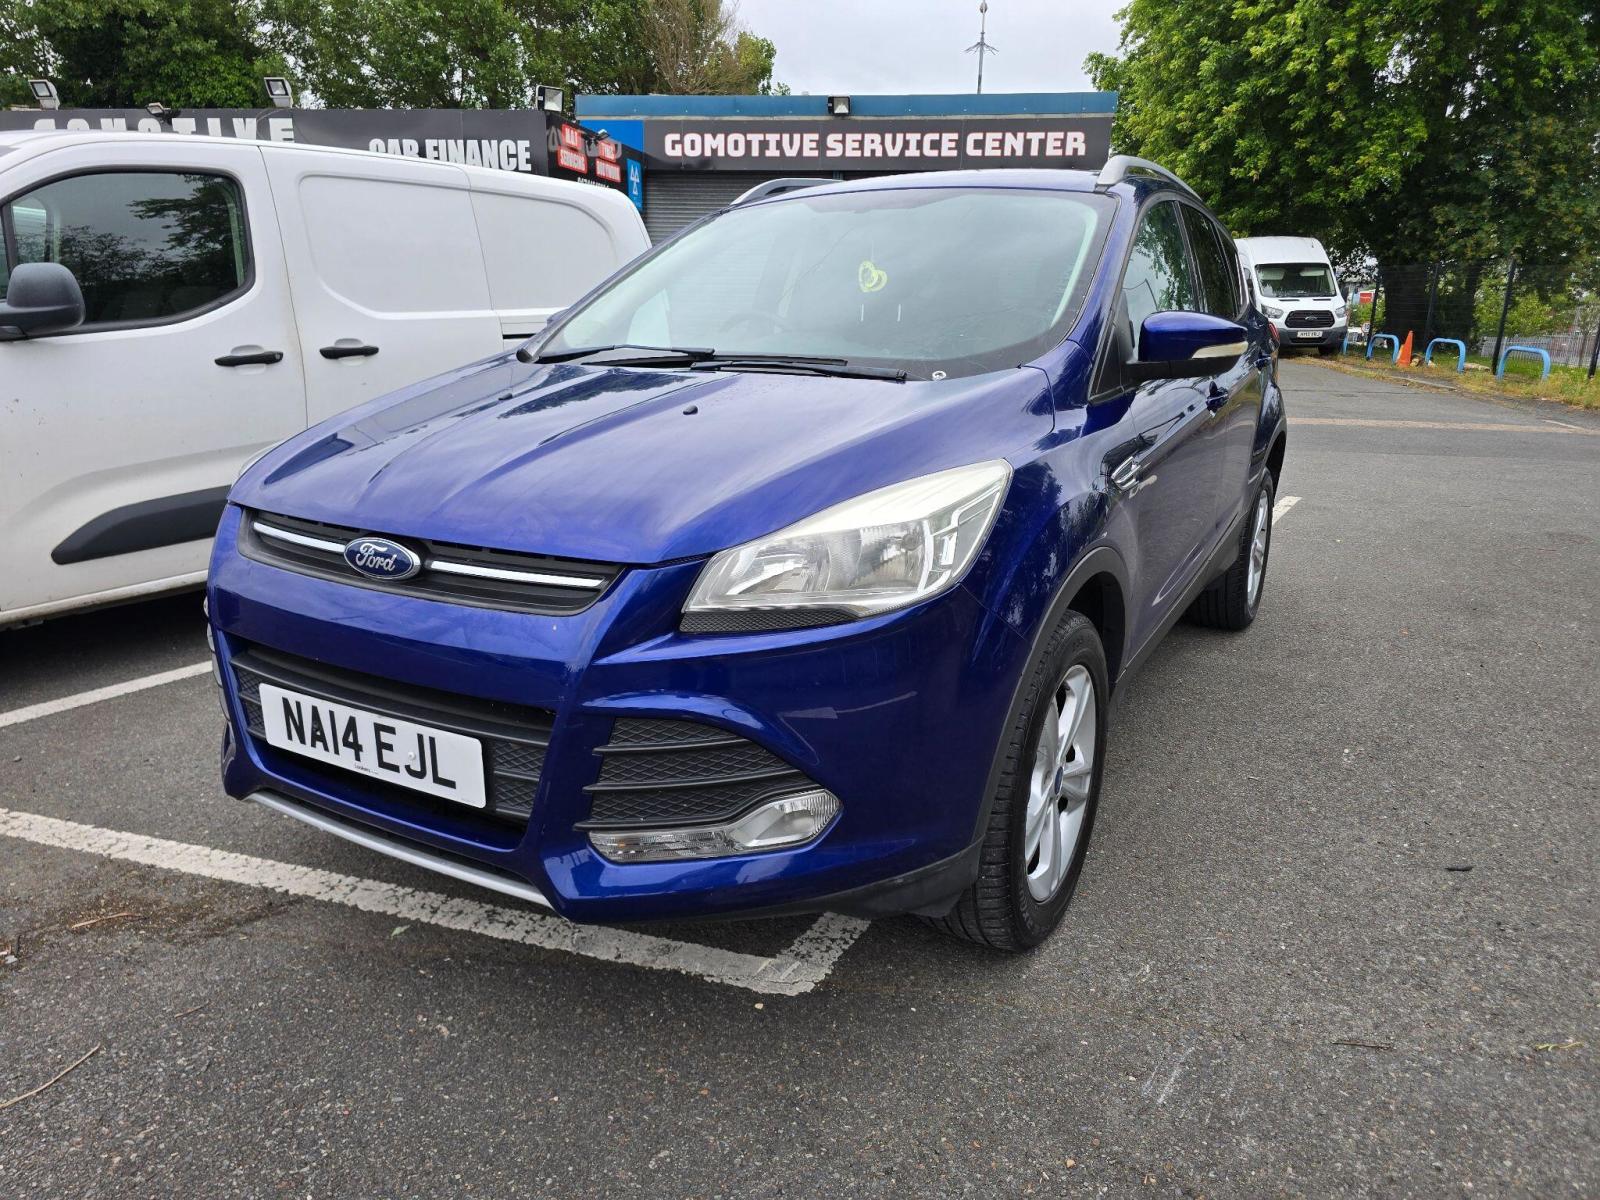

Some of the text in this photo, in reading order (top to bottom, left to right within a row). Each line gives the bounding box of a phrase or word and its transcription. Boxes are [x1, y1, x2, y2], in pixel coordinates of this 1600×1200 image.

[425, 139, 532, 172] FINANCE
[664, 131, 1087, 158] GOMOTIVE SERVICE CENTER
[355, 542, 398, 573] Ford
[281, 696, 457, 790] NA14 EJL
